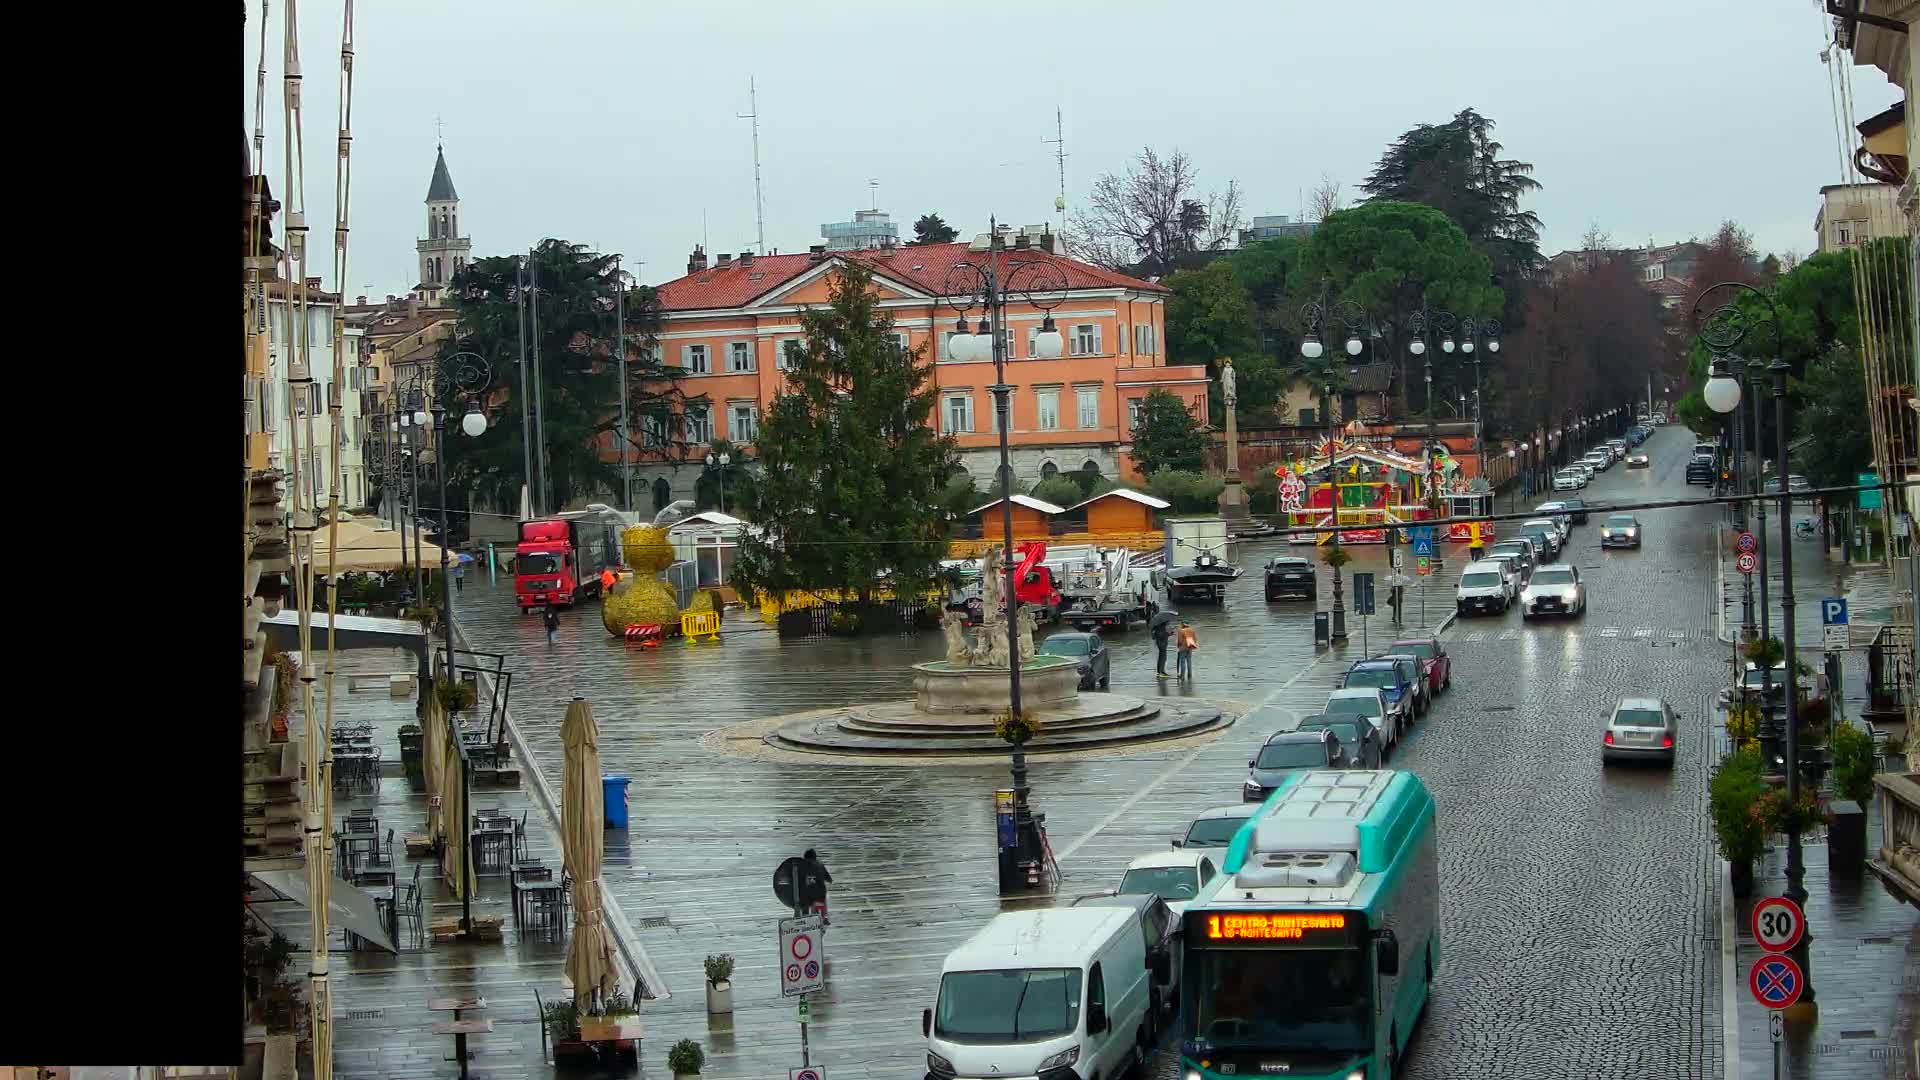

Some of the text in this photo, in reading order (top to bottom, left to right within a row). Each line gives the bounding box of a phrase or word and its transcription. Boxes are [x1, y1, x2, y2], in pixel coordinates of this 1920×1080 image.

[1828, 602, 1842, 621] P
[1209, 915, 1222, 938] 1
[1763, 912, 1791, 937] 30
